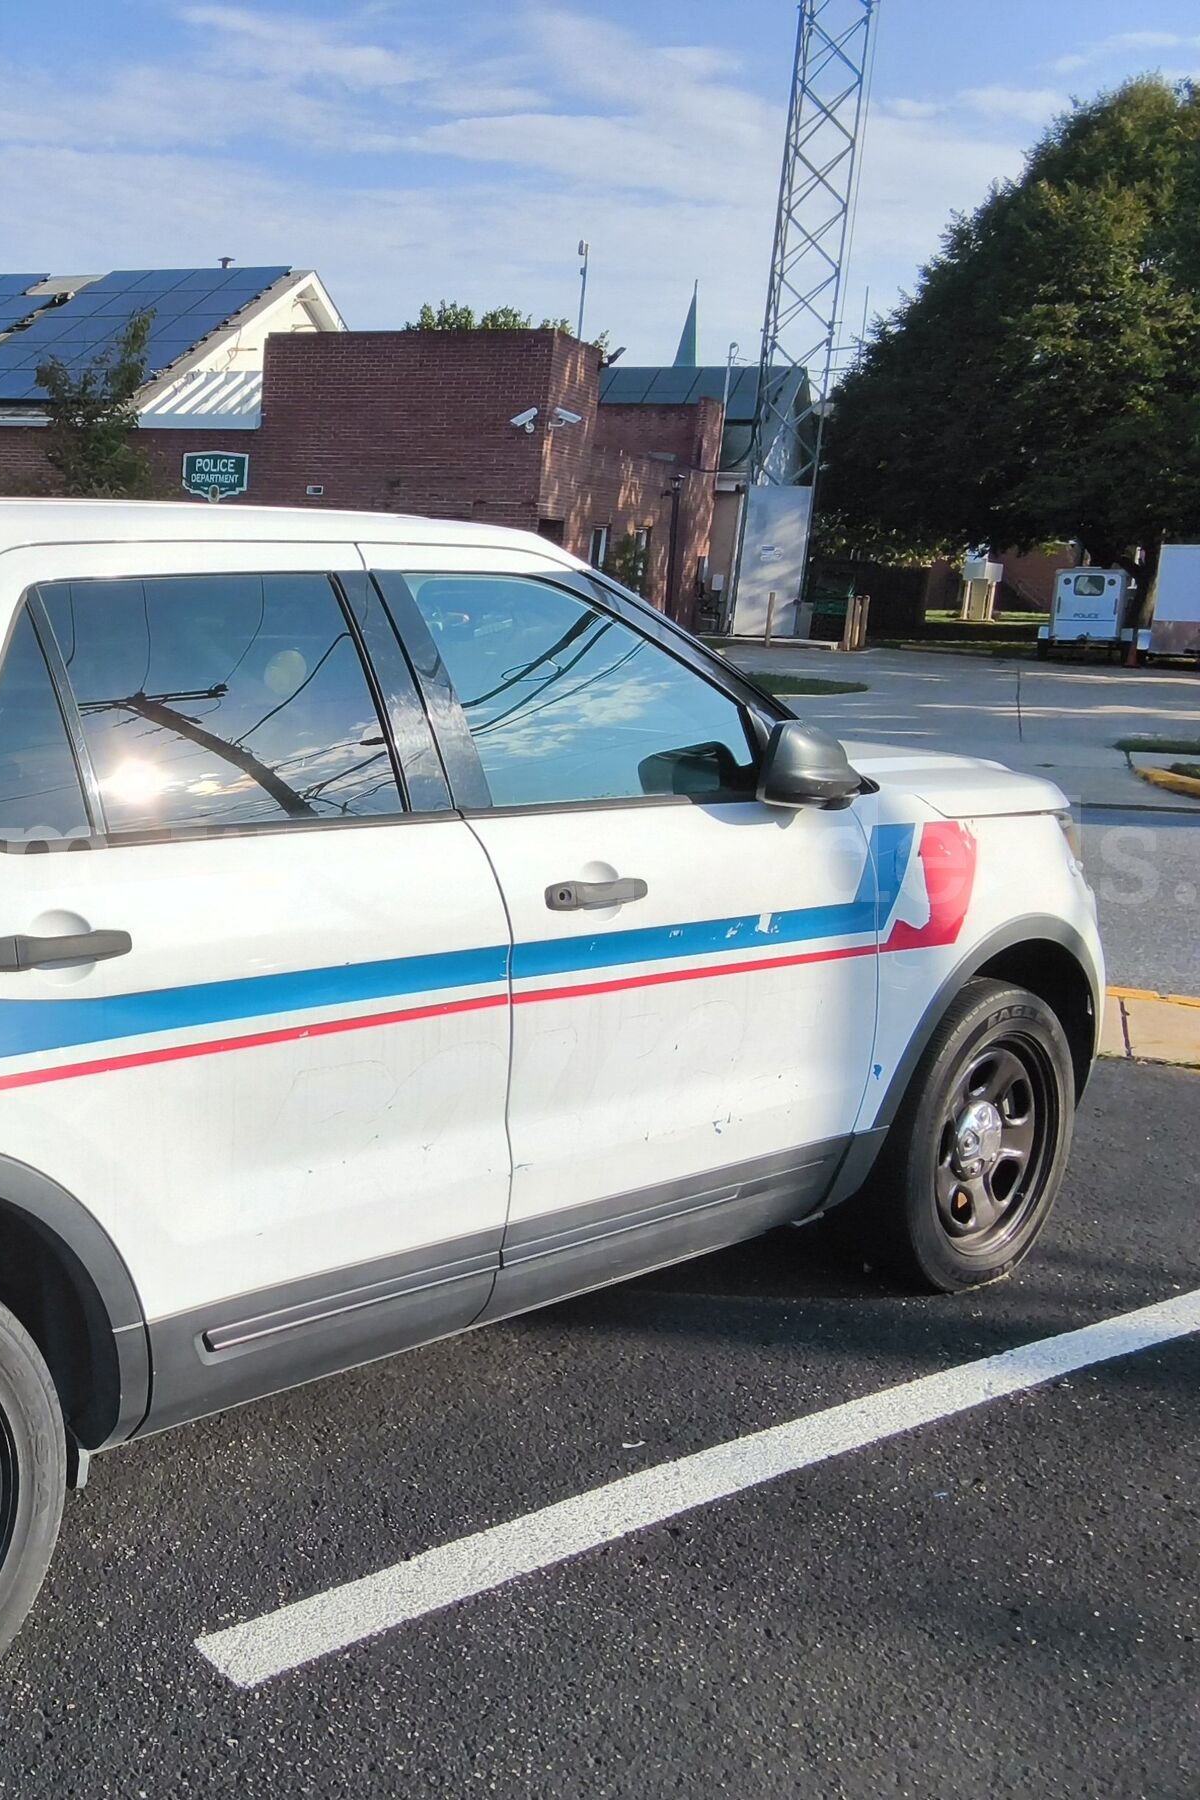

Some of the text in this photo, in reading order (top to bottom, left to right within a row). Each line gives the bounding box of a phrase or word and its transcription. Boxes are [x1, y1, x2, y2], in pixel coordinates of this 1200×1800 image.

[195, 457, 236, 472] POLICE
[191, 473, 239, 484] DEPARTMENT
[1073, 612, 1099, 620] POLICE
